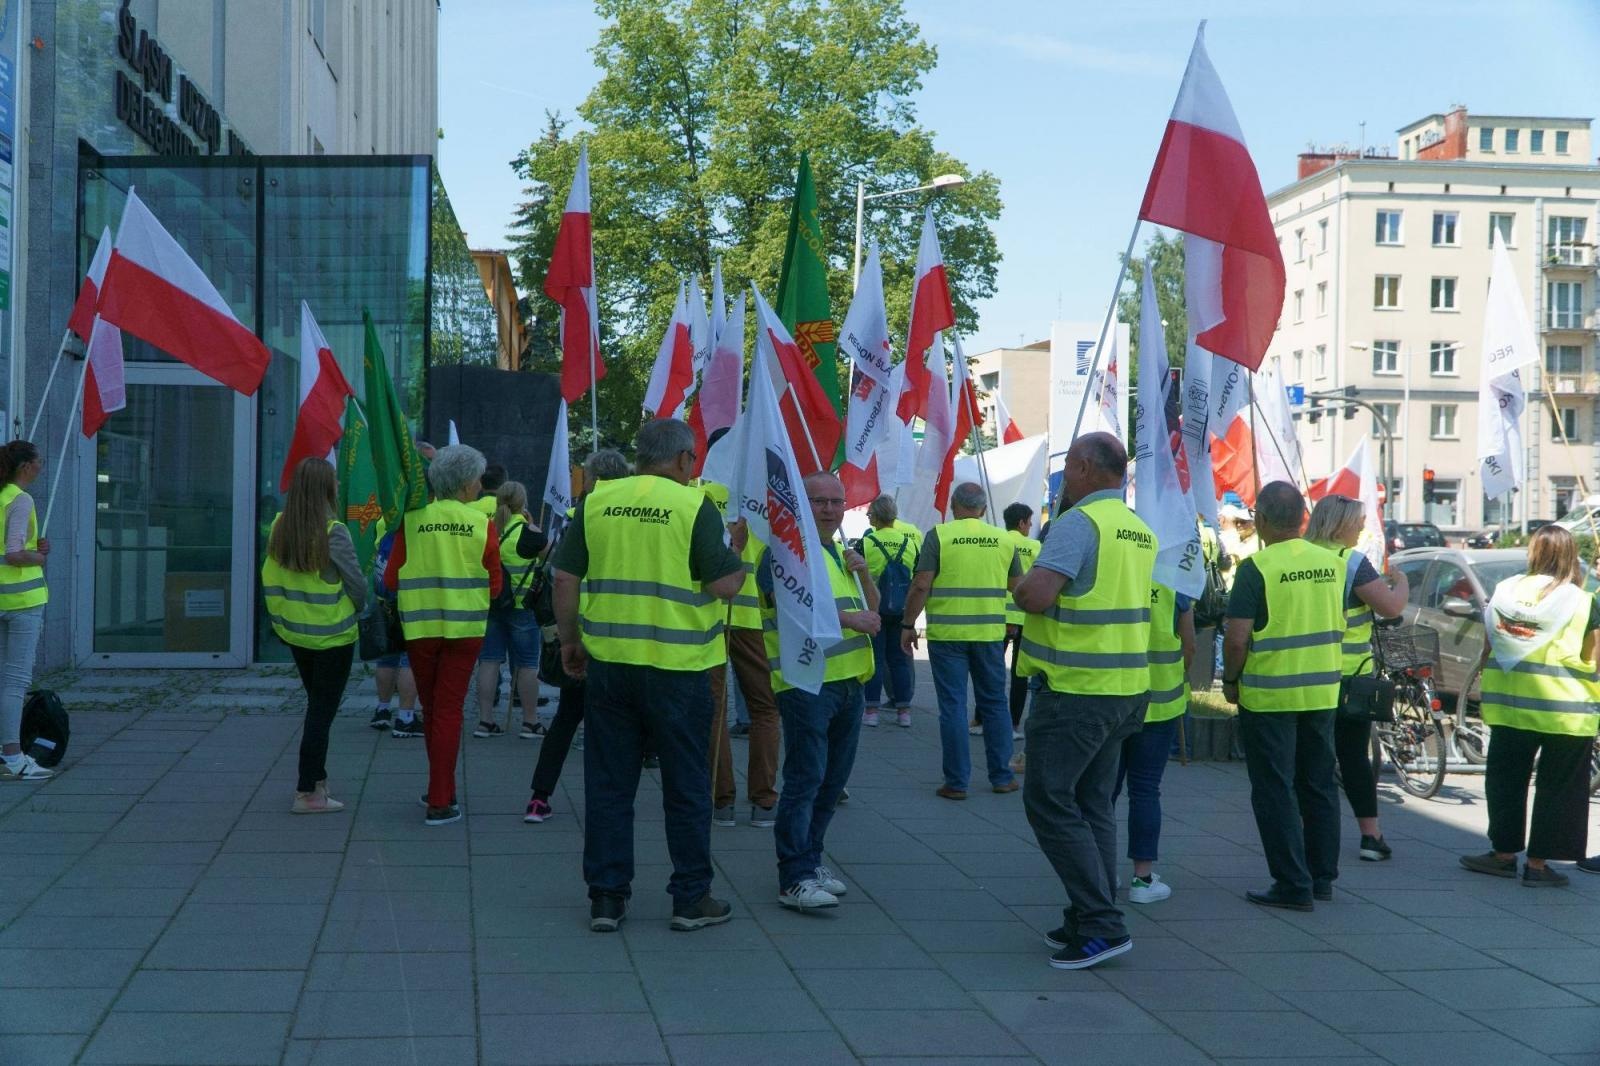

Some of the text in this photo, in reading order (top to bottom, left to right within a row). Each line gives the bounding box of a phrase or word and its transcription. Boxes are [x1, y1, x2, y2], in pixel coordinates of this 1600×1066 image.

[116, 70, 200, 156] DELEGATU
[603, 506, 673, 520] AGROMAX
[417, 523, 475, 534] AGROMAX
[1116, 528, 1152, 543] AGROMAX
[952, 537, 999, 545] AGROMAX
[1280, 568, 1336, 583] AGROMAX
